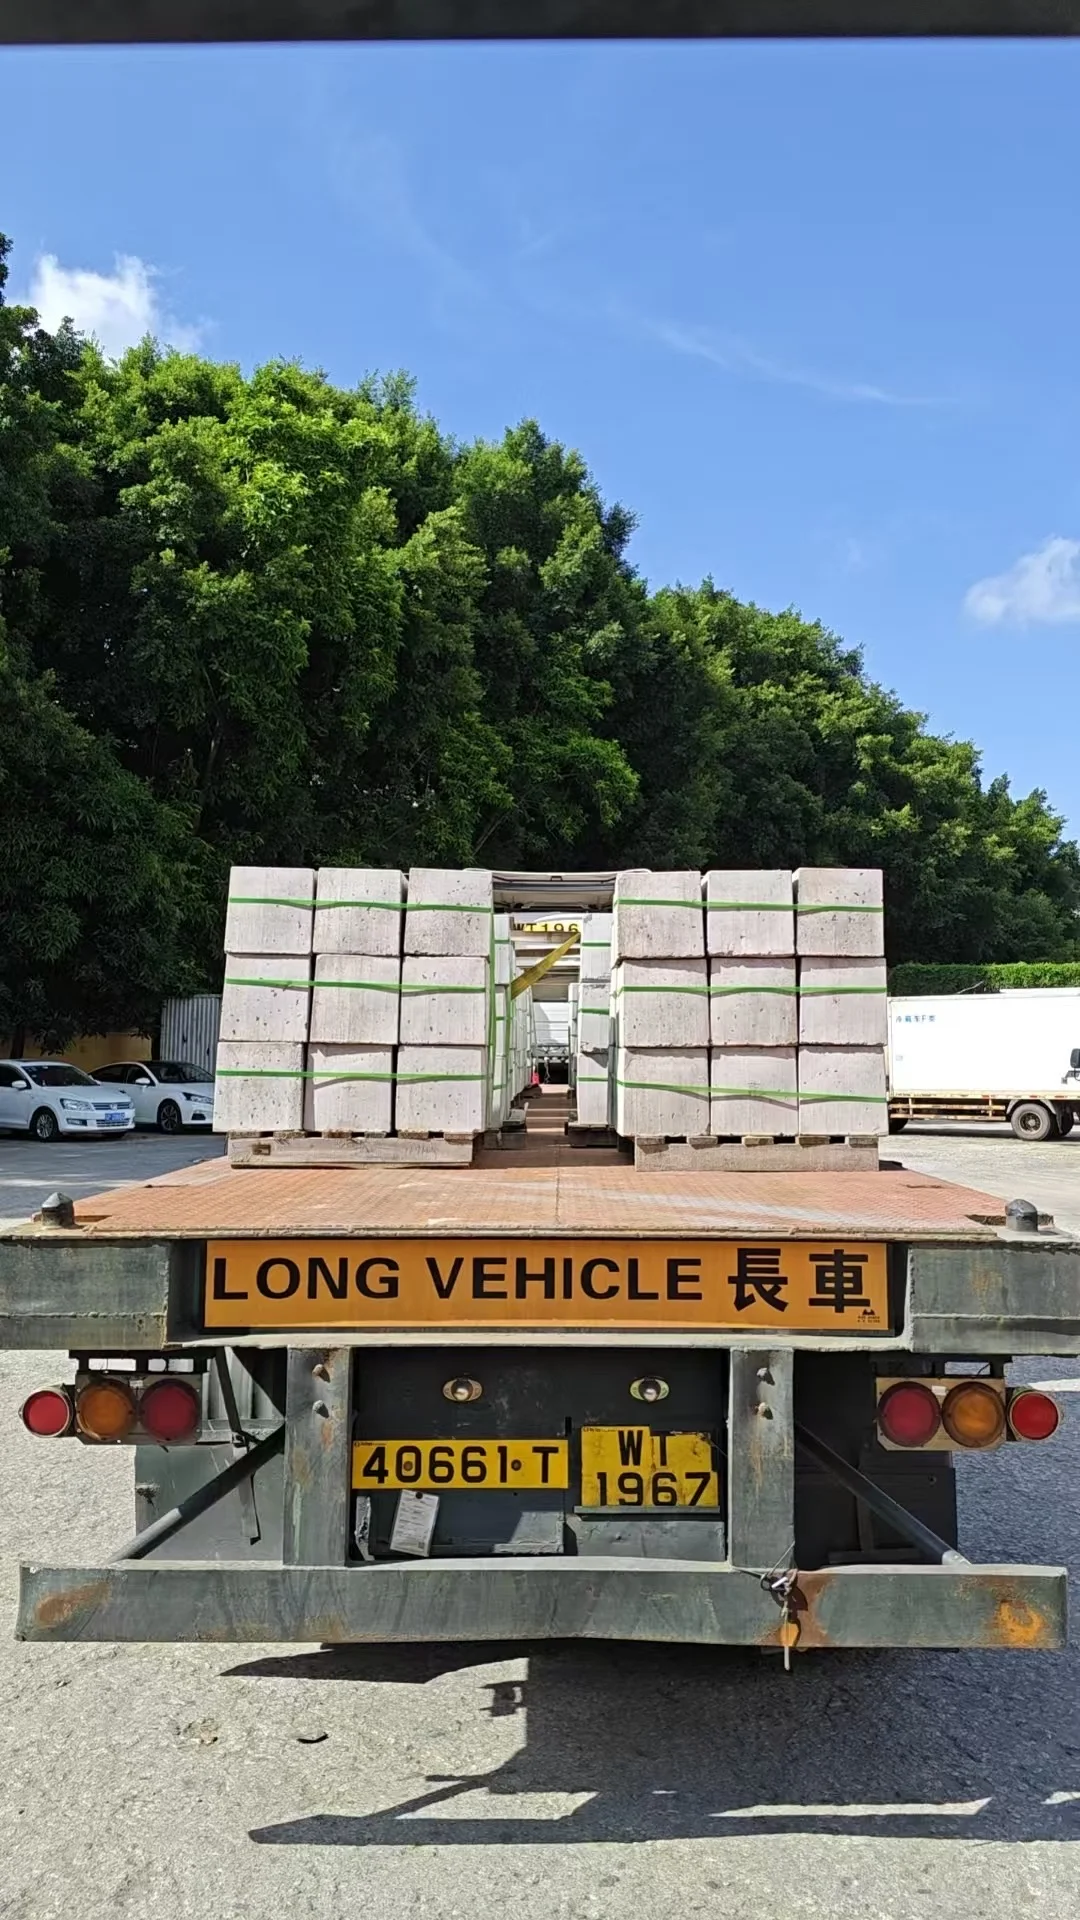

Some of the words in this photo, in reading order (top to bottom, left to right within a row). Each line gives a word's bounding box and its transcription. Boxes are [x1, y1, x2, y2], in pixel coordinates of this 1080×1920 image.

[213, 1257, 400, 1300] LONG
[425, 1257, 702, 1300] VEHICLE
[728, 1247, 871, 1313] 長車
[362, 1445, 508, 1484] 40661
[532, 1446, 560, 1484] T
[597, 1472, 711, 1506] 1967
